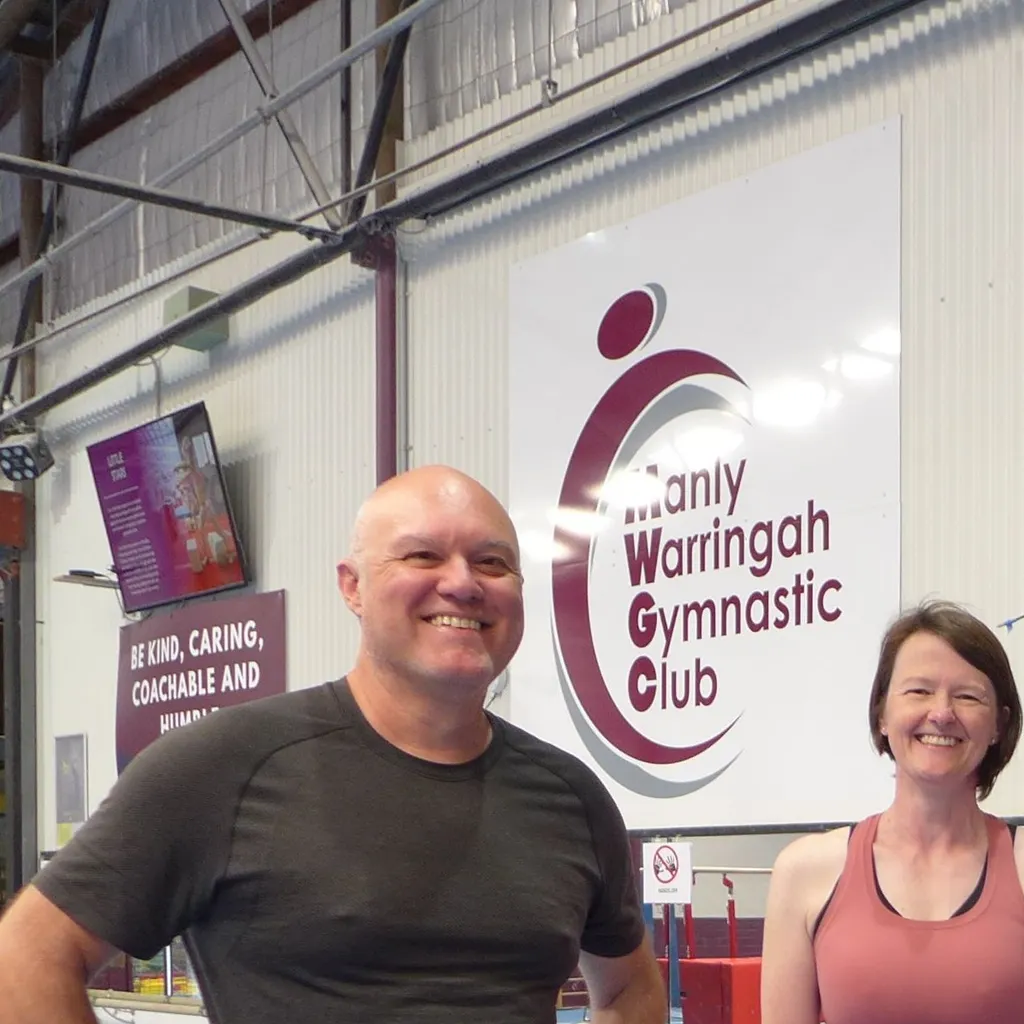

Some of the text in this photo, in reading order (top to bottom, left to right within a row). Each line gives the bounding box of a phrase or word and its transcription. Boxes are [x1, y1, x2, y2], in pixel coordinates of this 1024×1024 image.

[624, 499, 830, 587] Warringah
[628, 569, 843, 658] Gymnastic
[131, 620, 264, 670] BE KIND, CARING,
[132, 661, 260, 707] COACHABLE AND
[628, 656, 718, 712] Club
